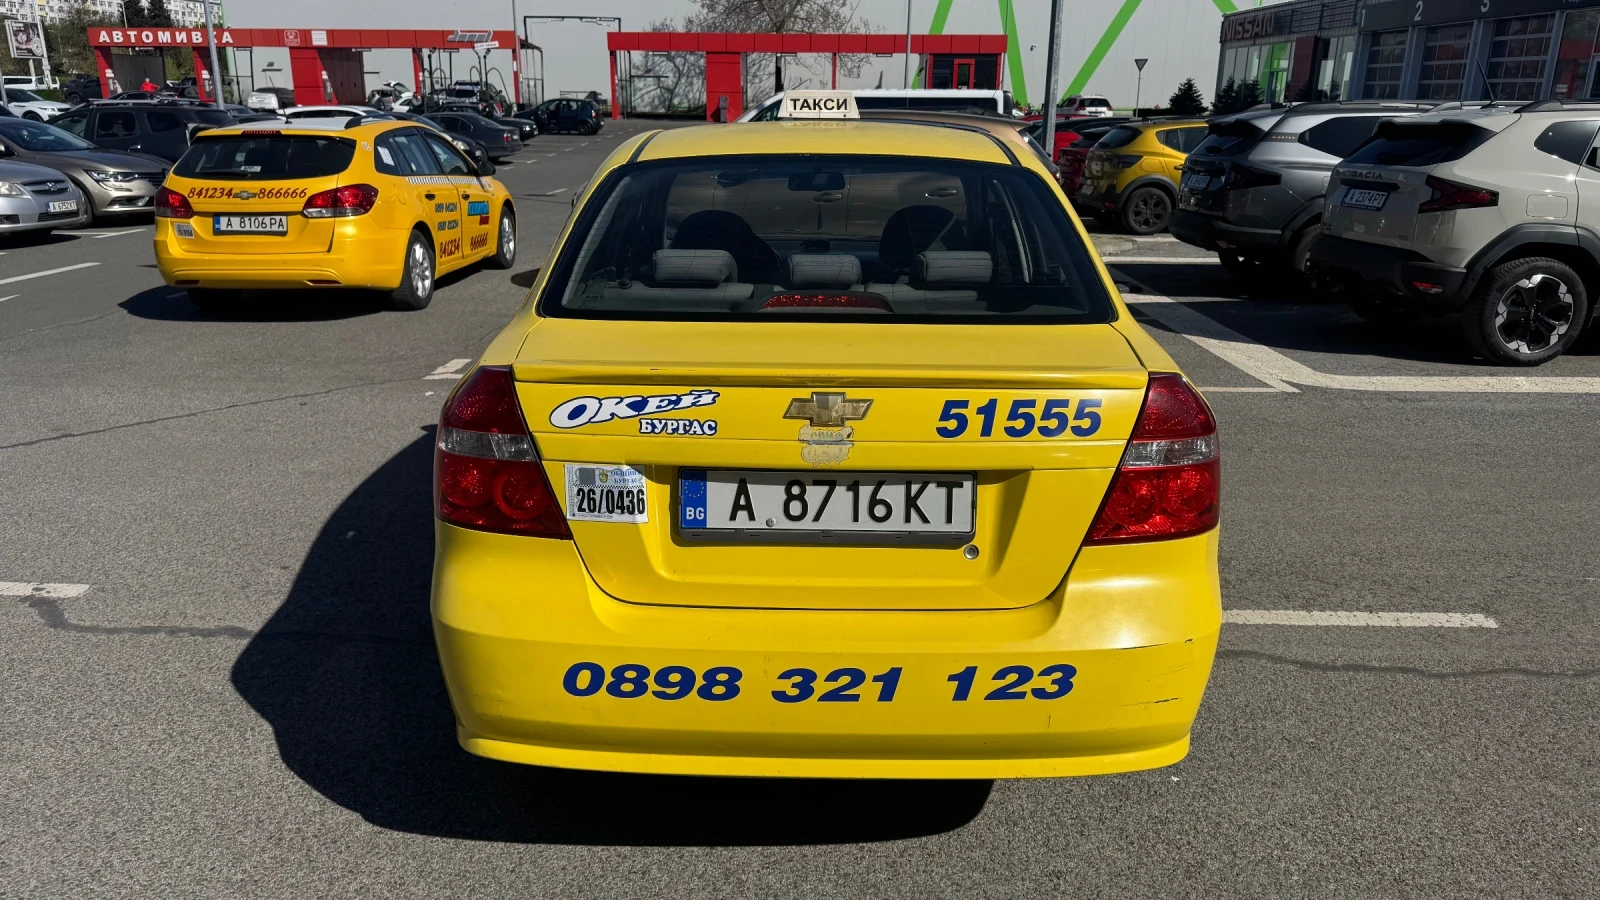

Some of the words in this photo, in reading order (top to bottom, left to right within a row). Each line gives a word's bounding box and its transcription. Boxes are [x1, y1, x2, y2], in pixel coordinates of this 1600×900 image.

[1414, 1, 1423, 21] 2
[1222, 12, 1275, 41] NISSAN
[789, 98, 848, 111] ТАКСИ
[1351, 171, 1383, 180] DACIA
[187, 187, 234, 199] 841234
[257, 187, 308, 199] 866666
[226, 217, 233, 229] A
[549, 389, 721, 429] ОКЕЙ
[935, 398, 1102, 439] 51555
[639, 418, 718, 436] БУРГАС
[577, 488, 645, 514] 26/0436
[686, 506, 705, 520] BG
[729, 478, 756, 522] A
[562, 661, 743, 702] 0898
[771, 666, 903, 704] 321
[947, 664, 1078, 701] 123
